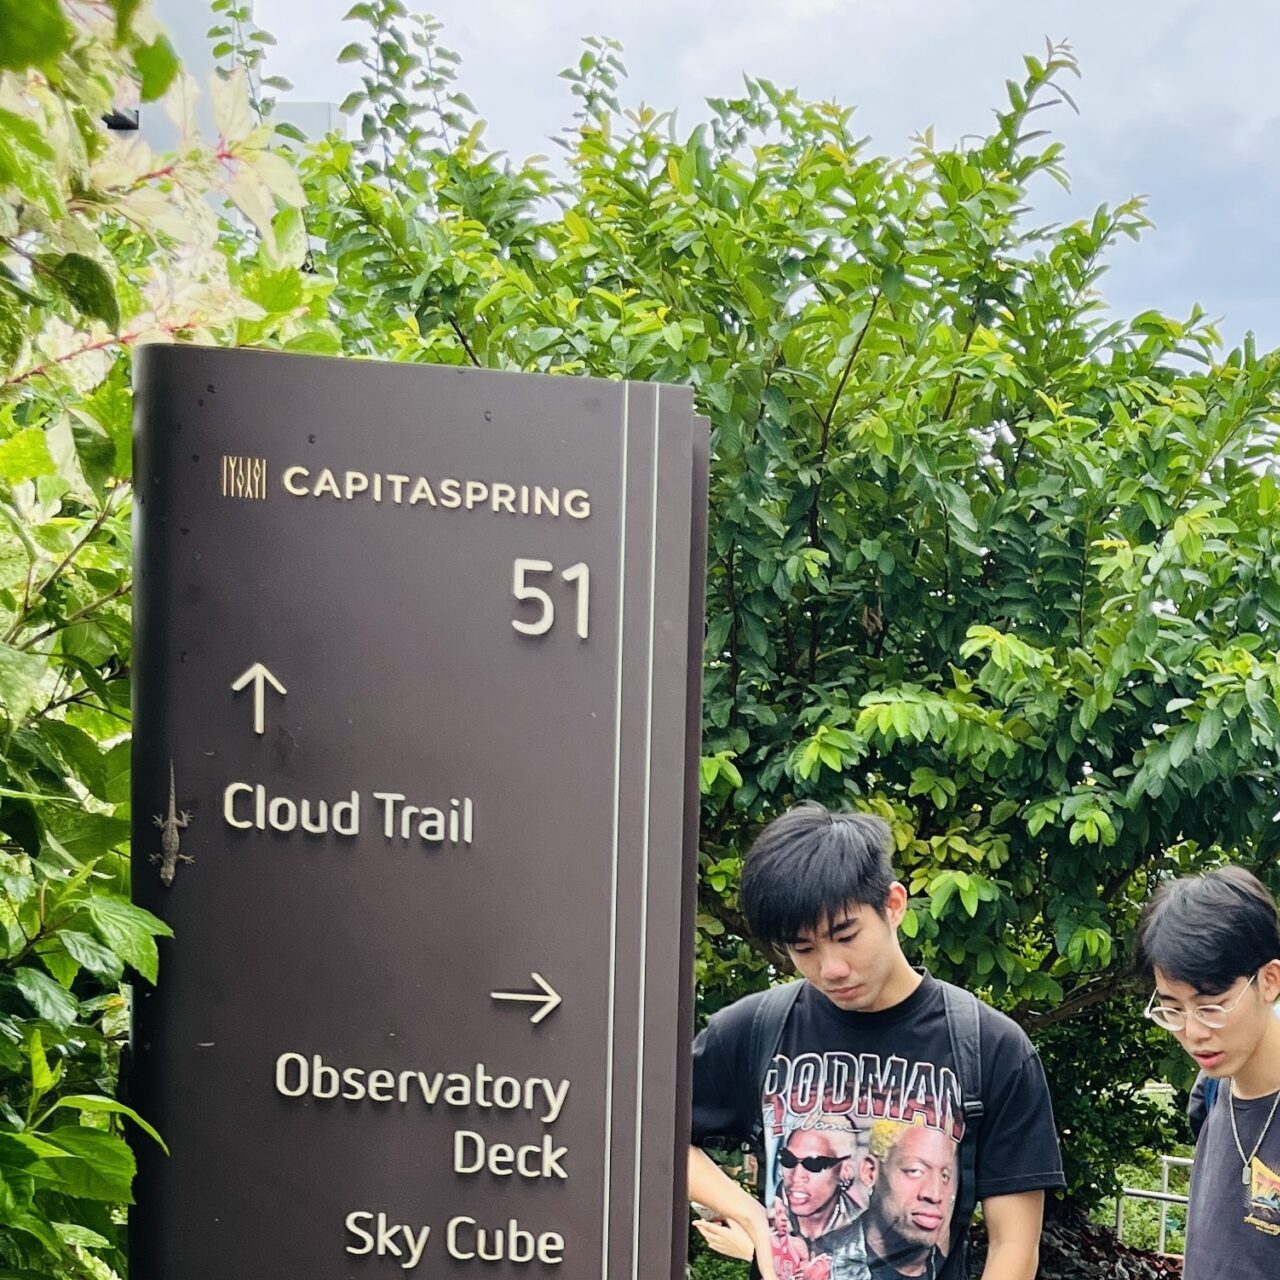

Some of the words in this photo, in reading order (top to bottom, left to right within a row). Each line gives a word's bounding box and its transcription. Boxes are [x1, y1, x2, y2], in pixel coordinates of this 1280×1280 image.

[282, 465, 591, 520] CAPITASPRING
[511, 557, 590, 639] 51
[222, 782, 360, 836] Cloud
[371, 791, 473, 845] Trail
[274, 1052, 571, 1123] Observatory
[763, 1052, 965, 1142] RODMAN
[453, 1130, 570, 1180] Deck
[344, 1211, 431, 1270] Sky
[446, 1215, 566, 1265] Cube
